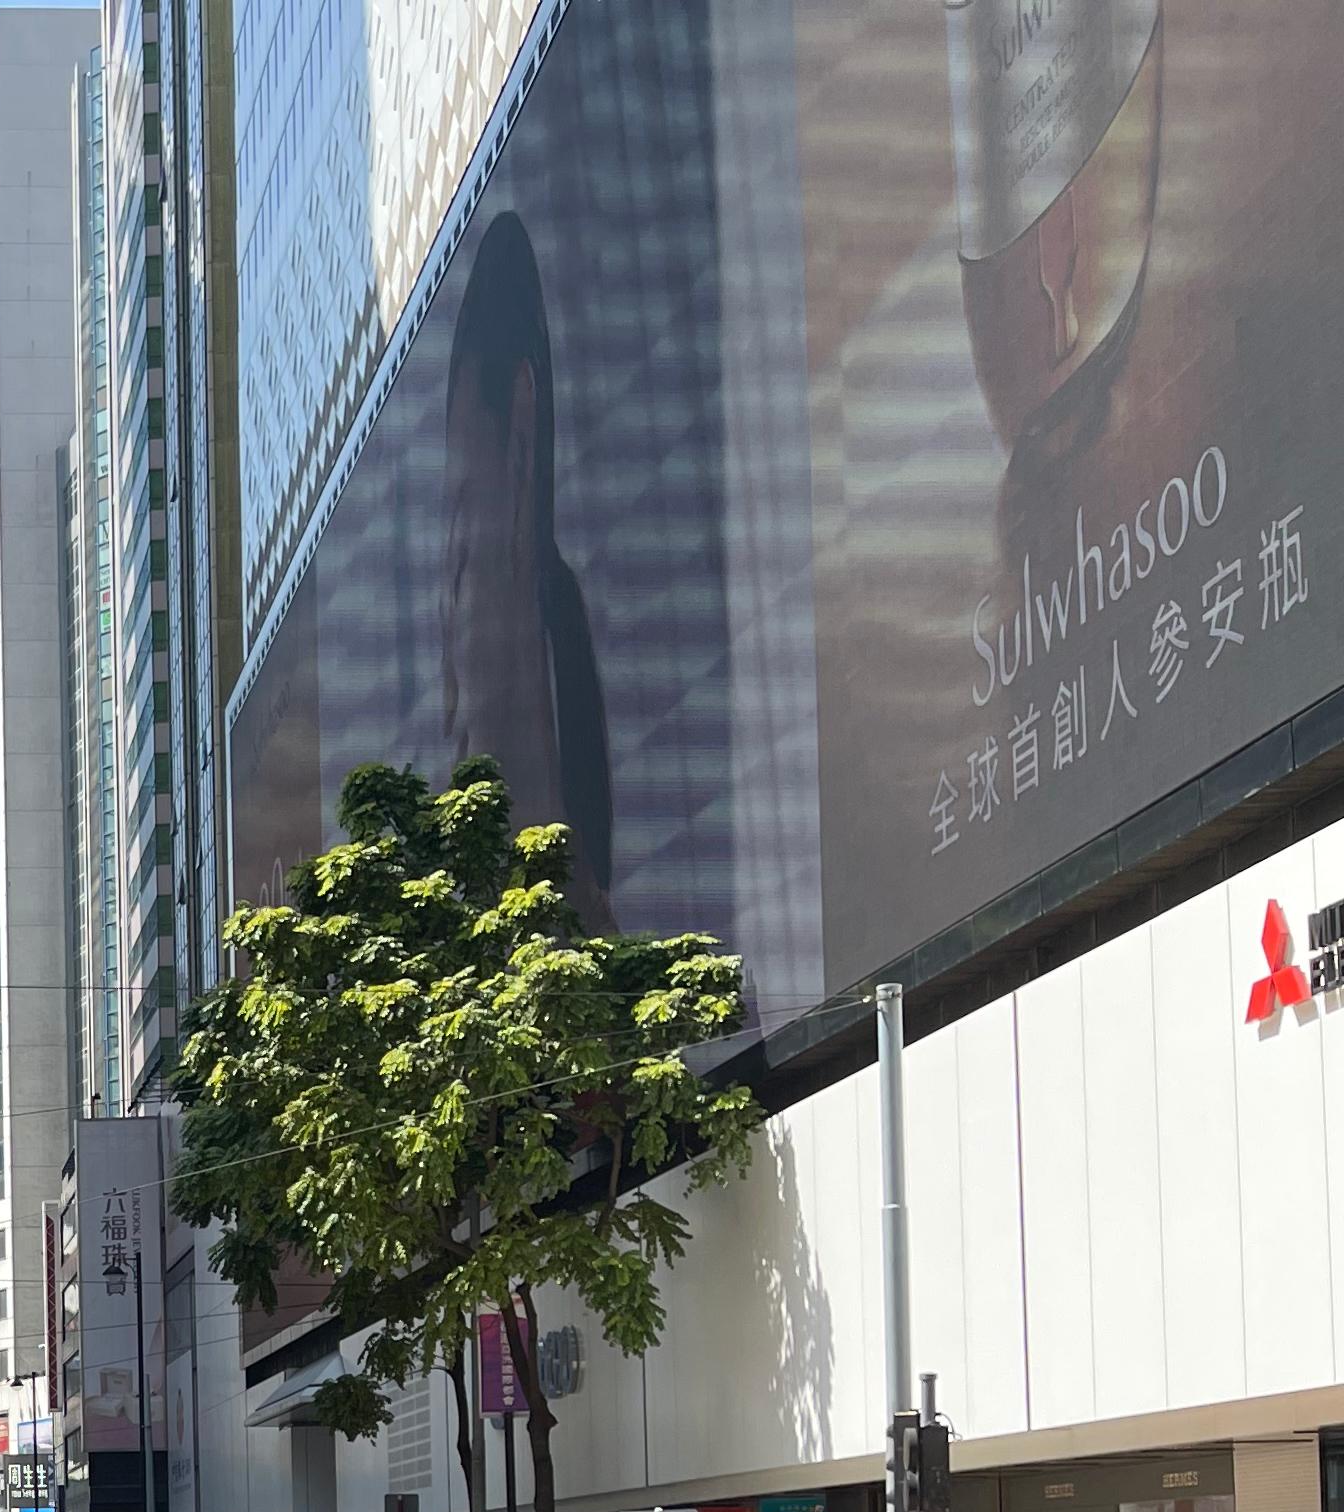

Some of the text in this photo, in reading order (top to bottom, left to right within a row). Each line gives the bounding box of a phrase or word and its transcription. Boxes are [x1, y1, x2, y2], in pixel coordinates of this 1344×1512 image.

[928, 505, 1310, 858] 全球首創人參安瓶
[970, 445, 1229, 707] Sulwhasoo
